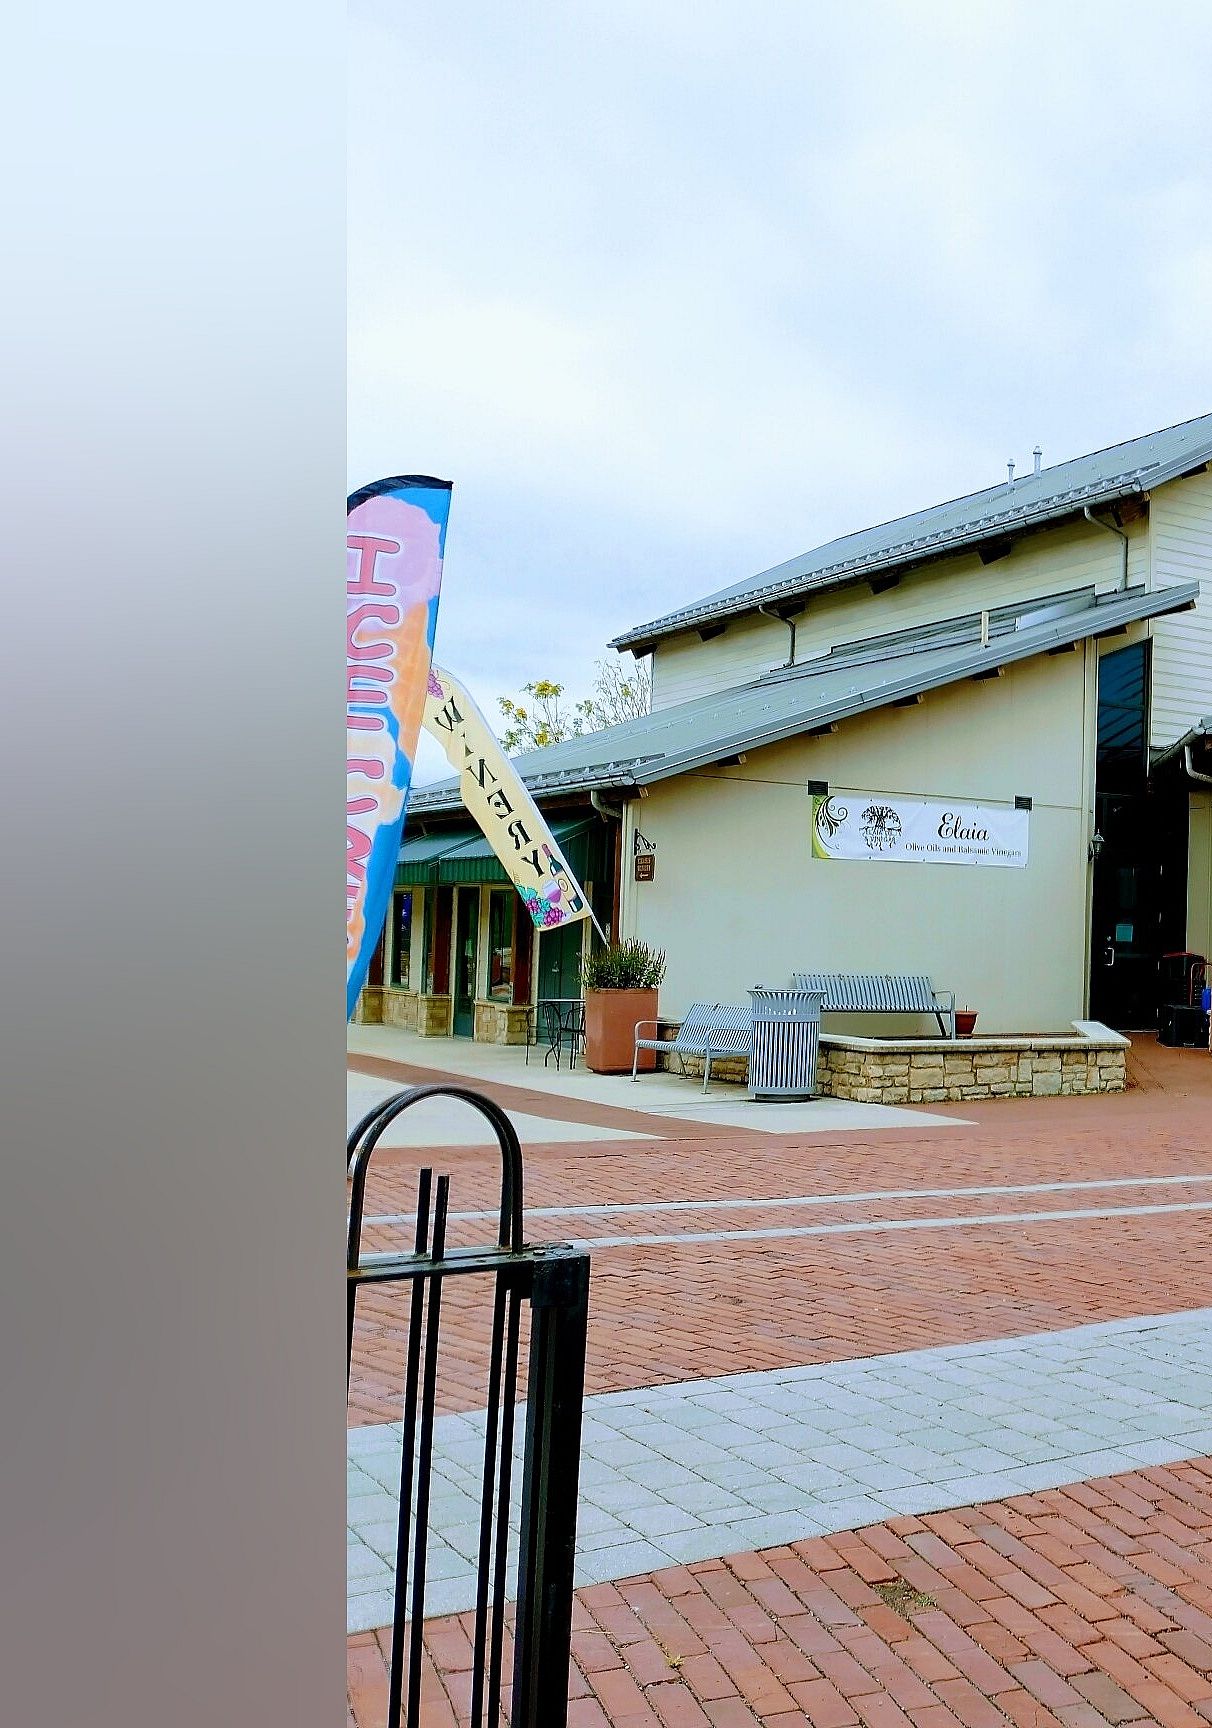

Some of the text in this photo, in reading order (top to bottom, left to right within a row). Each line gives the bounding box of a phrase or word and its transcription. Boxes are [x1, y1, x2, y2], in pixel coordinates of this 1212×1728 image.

[937, 812, 990, 841] Elaia
[905, 842, 925, 852] Olive
[926, 843, 941, 853] Oils
[942, 845, 957, 854] and
[959, 846, 990, 855] Balsamic
